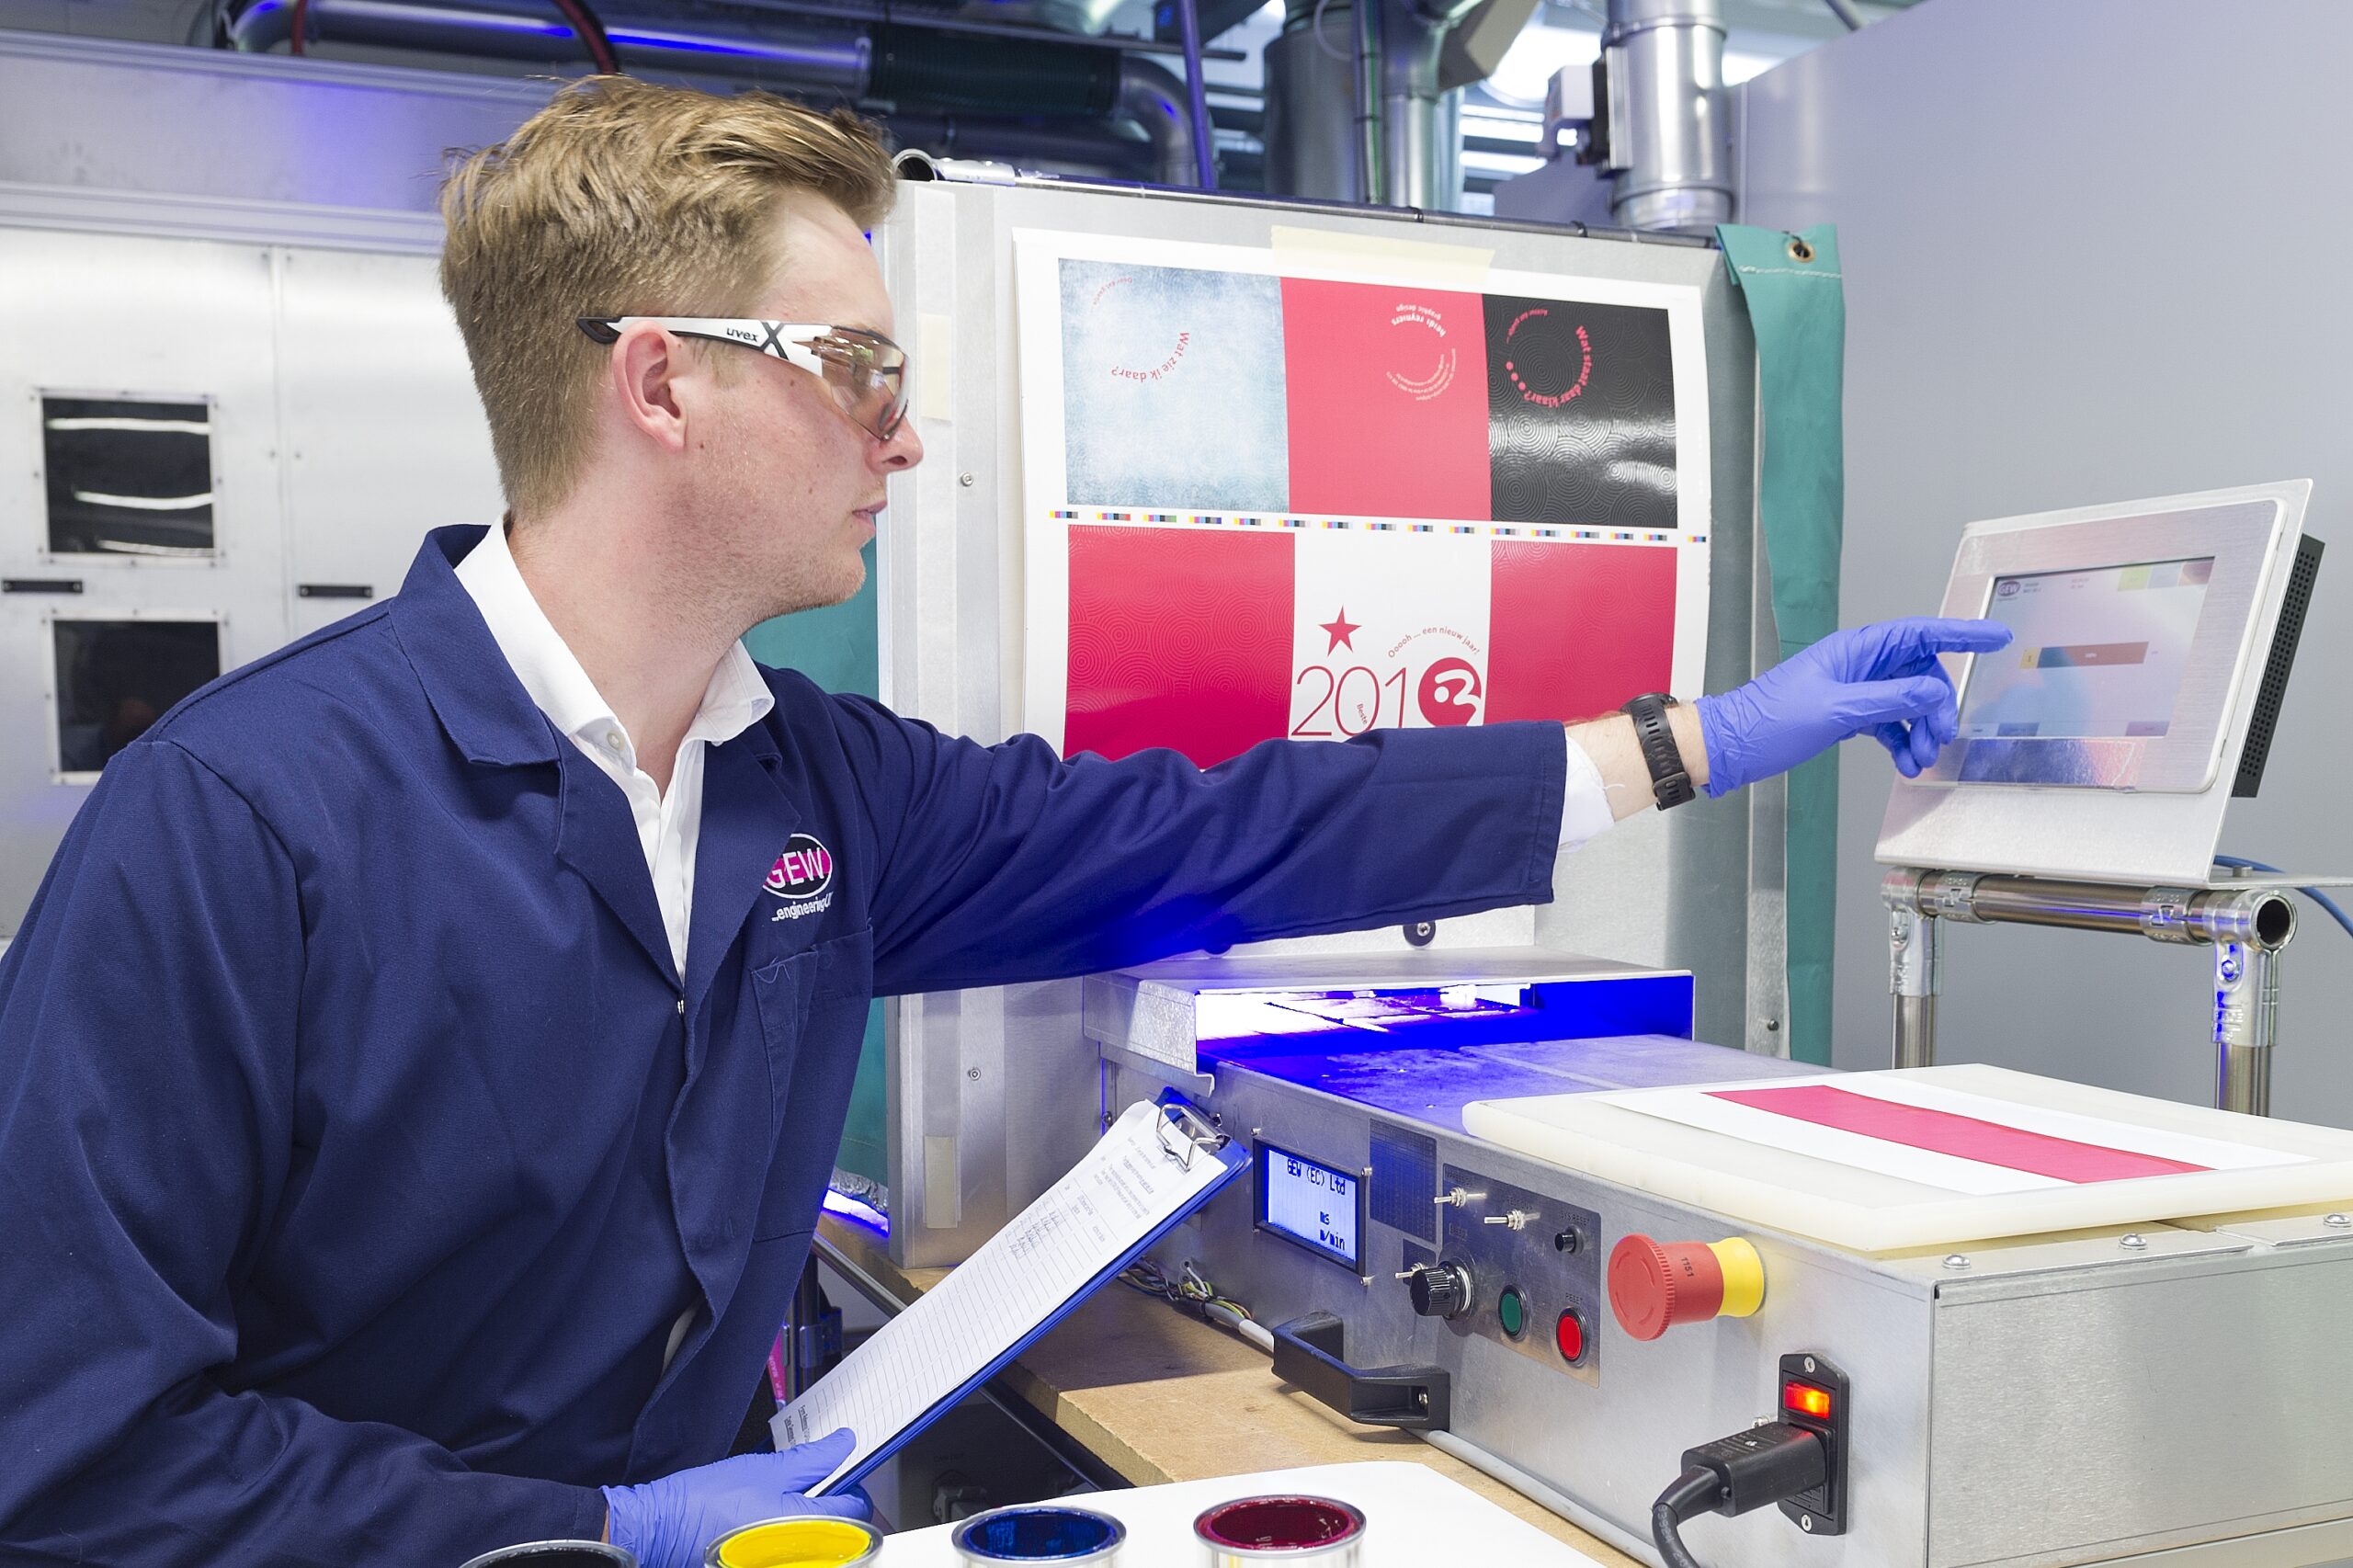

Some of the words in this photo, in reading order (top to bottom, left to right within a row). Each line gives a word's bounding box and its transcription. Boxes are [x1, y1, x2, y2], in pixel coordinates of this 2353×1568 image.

[1396, 303, 1416, 312] design
[726, 327, 758, 343] uvex
[1175, 332, 1190, 358] Wat
[1575, 324, 1592, 353] Wat
[1110, 366, 1147, 383] daar?
[1149, 369, 1162, 381] ik
[1161, 357, 1176, 372] zie
[1438, 625, 1463, 641] nieuw
[1462, 635, 1480, 655] jaar!
[1357, 702, 1368, 725] Beste
[1306, 1165, 1325, 1187] (EC)
[1329, 1174, 1346, 1196] Ltd
[1680, 1256, 1695, 1278] 1151
